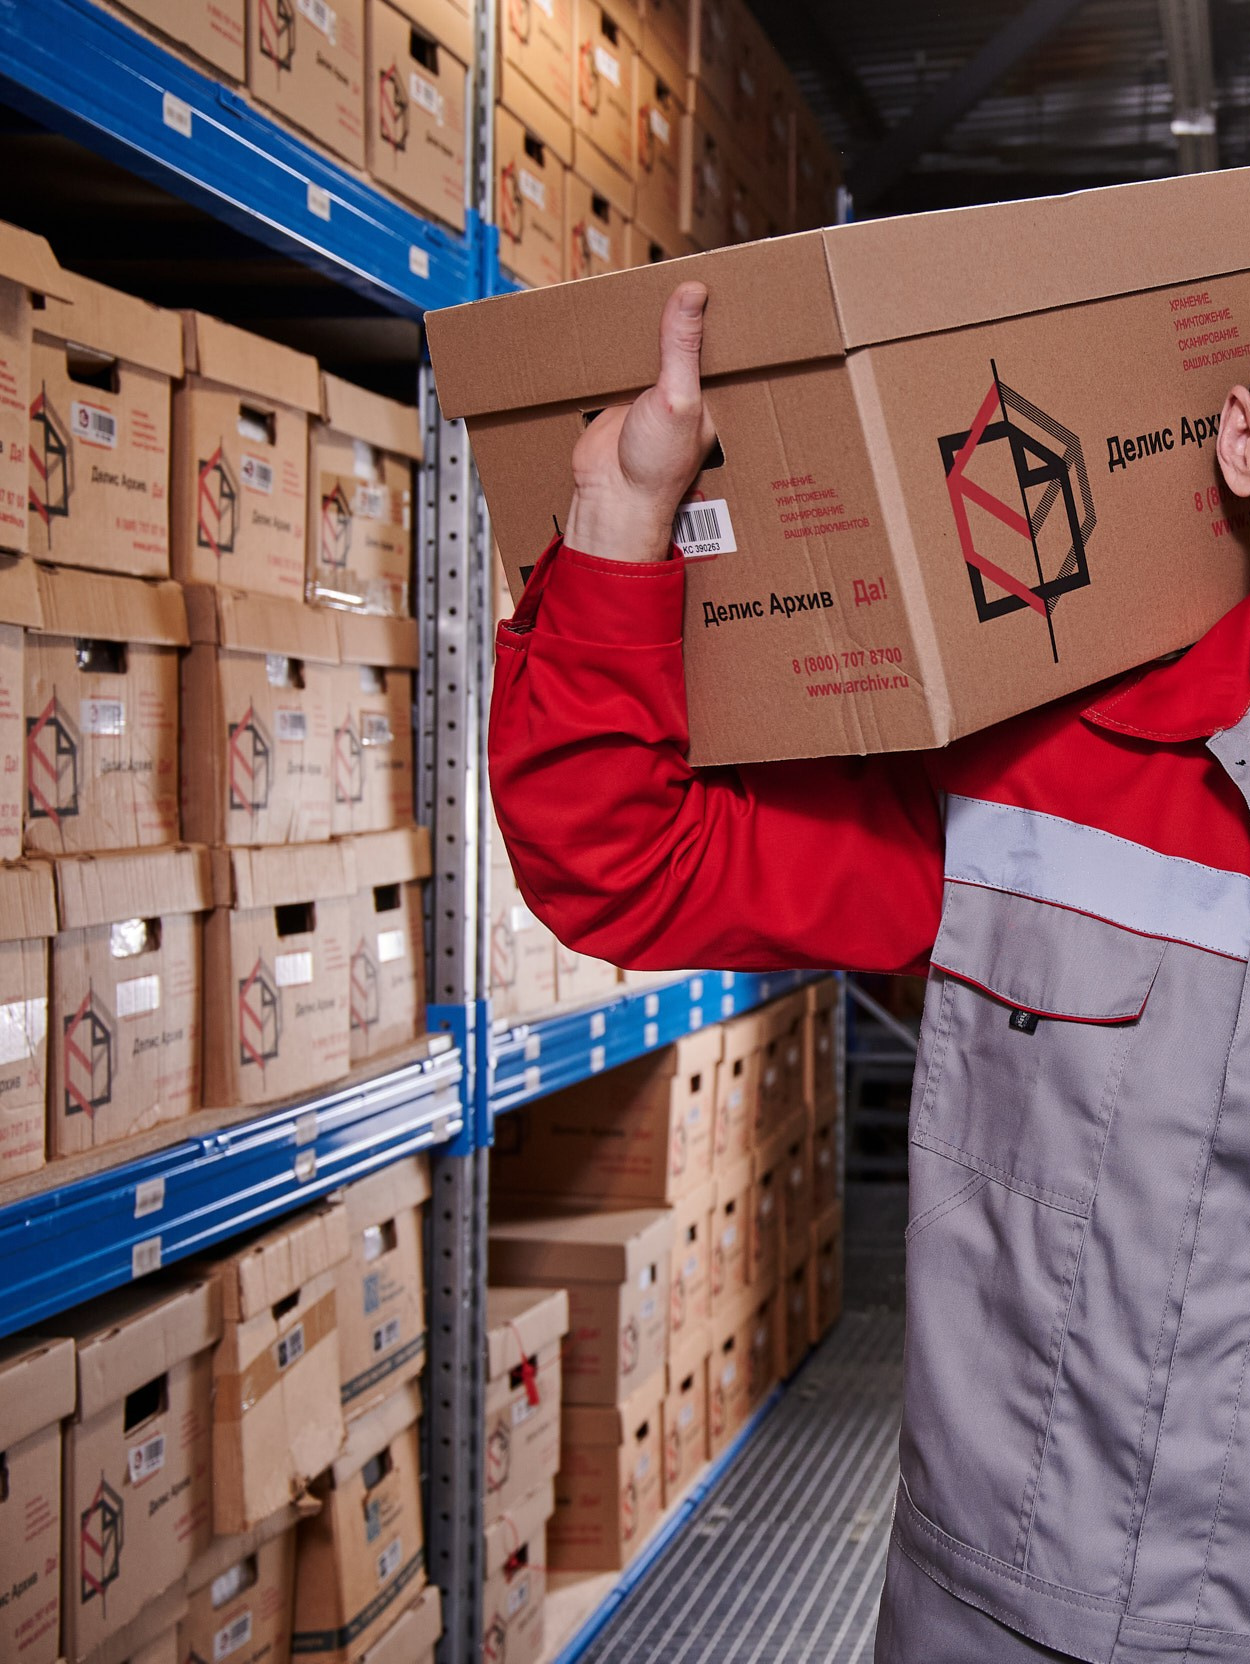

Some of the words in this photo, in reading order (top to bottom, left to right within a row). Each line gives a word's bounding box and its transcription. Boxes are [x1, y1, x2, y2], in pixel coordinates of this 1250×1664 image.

[1169, 292, 1213, 312] ХРАНЕНИЕ,
[1173, 307, 1234, 332] УНИЧТОЖЕНИЕ,
[1178, 326, 1240, 352] СКАНИРОВАНИЕ
[1182, 354, 1212, 372] ВАШИХ
[1106, 427, 1175, 473] Делис
[1181, 413, 1221, 448] Арх
[770, 474, 817, 491] ХРАНЕНИЕ,
[775, 488, 839, 507] УНИЧТОЖЕНИЕ,
[1194, 491, 1204, 512] 8
[780, 503, 846, 523] СКАНИРОВАНИЕ
[783, 525, 814, 540] ВАШИХ
[814, 517, 870, 537] ДОКУМЕНТОВ
[695, 542, 721, 554] 390263
[702, 600, 764, 628] Делис
[769, 591, 834, 618] Архив
[852, 577, 888, 608] Да!
[792, 658, 801, 675] 8
[804, 653, 839, 677] (800)
[841, 650, 865, 669] 707
[869, 647, 903, 666] 8700
[806, 674, 910, 698] www.archiv.ru
[0, 1076, 21, 1099] рхив
